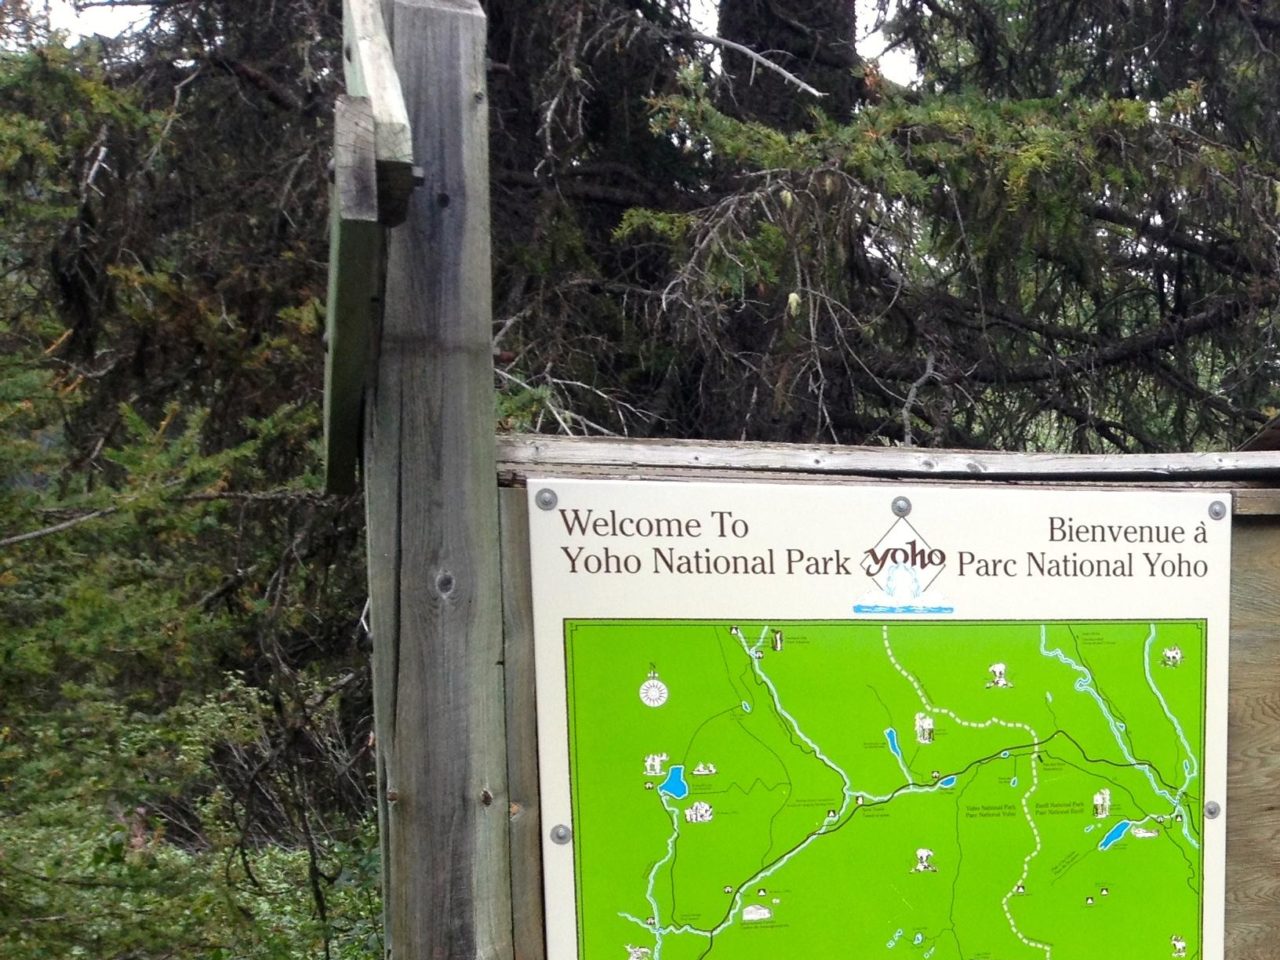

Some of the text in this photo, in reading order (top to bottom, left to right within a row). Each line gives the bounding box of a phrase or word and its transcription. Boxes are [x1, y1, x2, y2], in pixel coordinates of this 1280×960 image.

[558, 508, 749, 538] Welcome To
[1049, 516, 1208, 545] Bienvenue à
[561, 546, 852, 576] Yoho National Park
[863, 539, 946, 577] yoho
[958, 551, 1208, 578] Parc National Yoho
